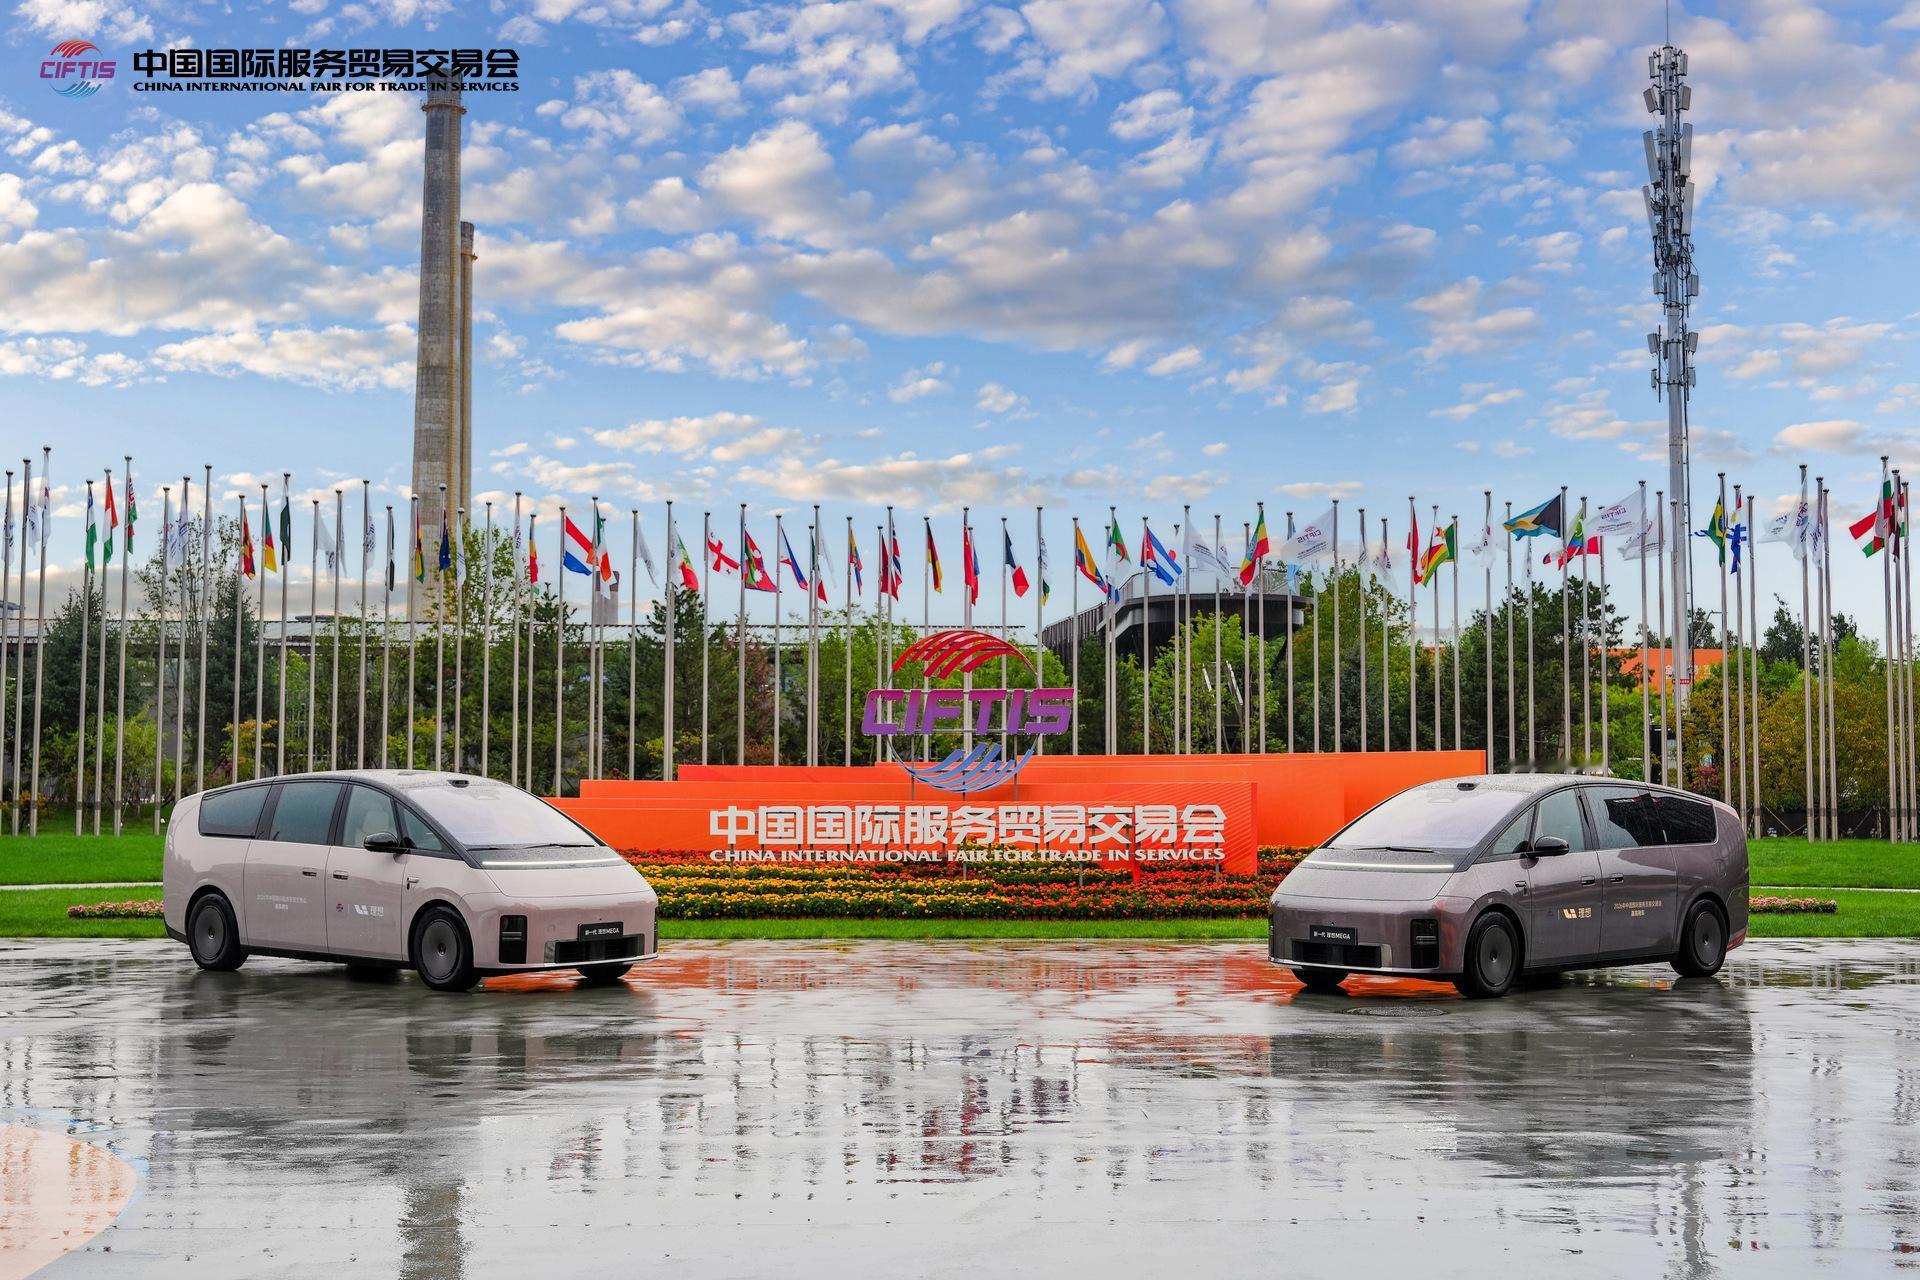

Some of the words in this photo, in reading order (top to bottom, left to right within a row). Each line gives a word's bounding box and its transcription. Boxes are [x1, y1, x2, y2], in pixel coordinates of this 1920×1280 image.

[862, 688, 1075, 736] CIFTIS
[709, 804, 1228, 845] 中国国际服务贸易交易会
[709, 850, 777, 862] CHINA
[781, 849, 943, 862] INTERNATIONAL
[948, 849, 988, 862] FAIR
[994, 849, 1033, 862] FOR
[1037, 849, 1103, 861] TRADE
[1108, 849, 1129, 861] IN
[1135, 848, 1226, 861] SERVICES
